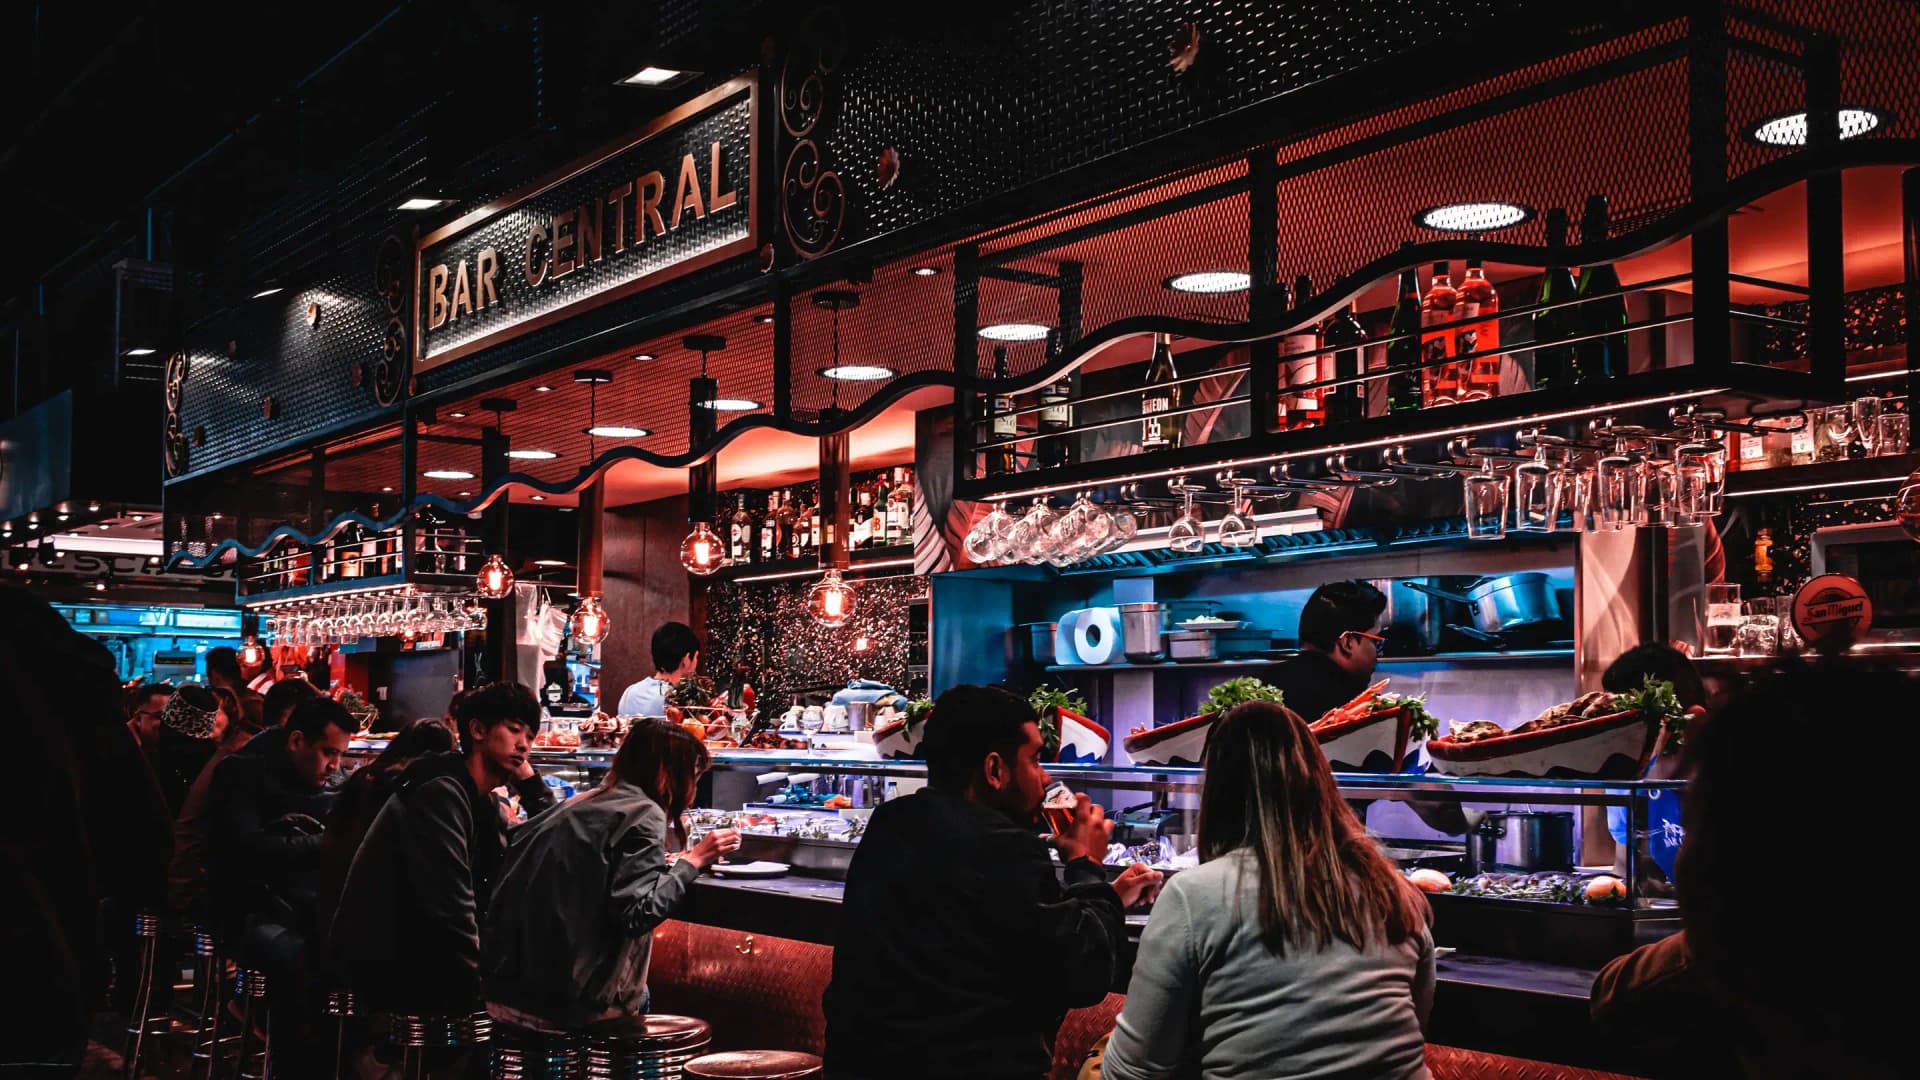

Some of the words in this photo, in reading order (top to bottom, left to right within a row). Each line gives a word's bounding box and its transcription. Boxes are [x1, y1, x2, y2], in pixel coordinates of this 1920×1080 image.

[428, 247, 499, 331] BAR
[525, 141, 738, 287] CENTRAL
[1807, 606, 1827, 619] San
